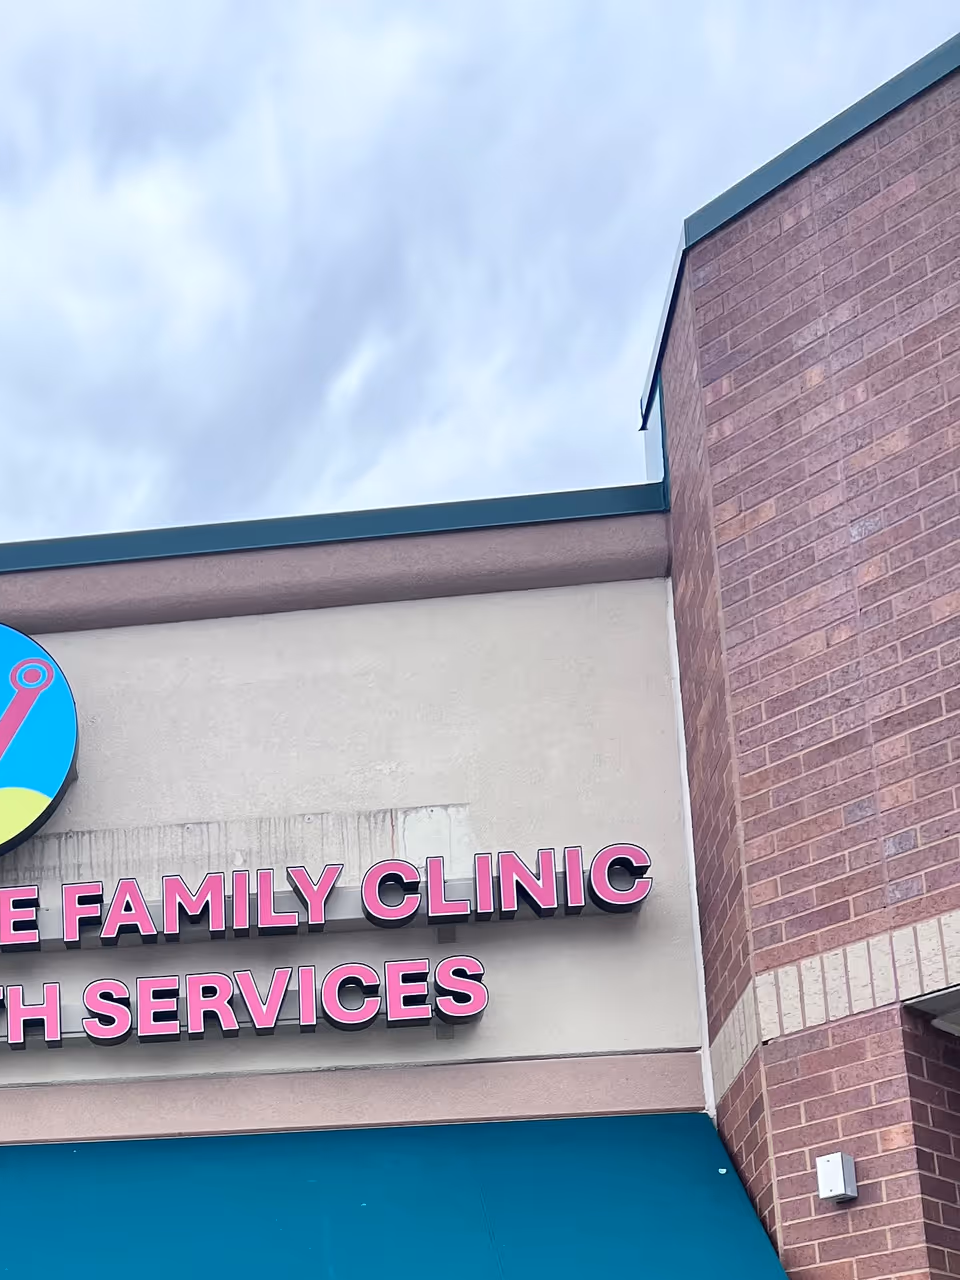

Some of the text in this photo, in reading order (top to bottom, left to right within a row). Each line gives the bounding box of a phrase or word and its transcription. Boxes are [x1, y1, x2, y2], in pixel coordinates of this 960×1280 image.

[62, 863, 344, 944] FAMILY
[361, 842, 654, 920] CLINIC
[82, 955, 489, 1041] SERVICES
